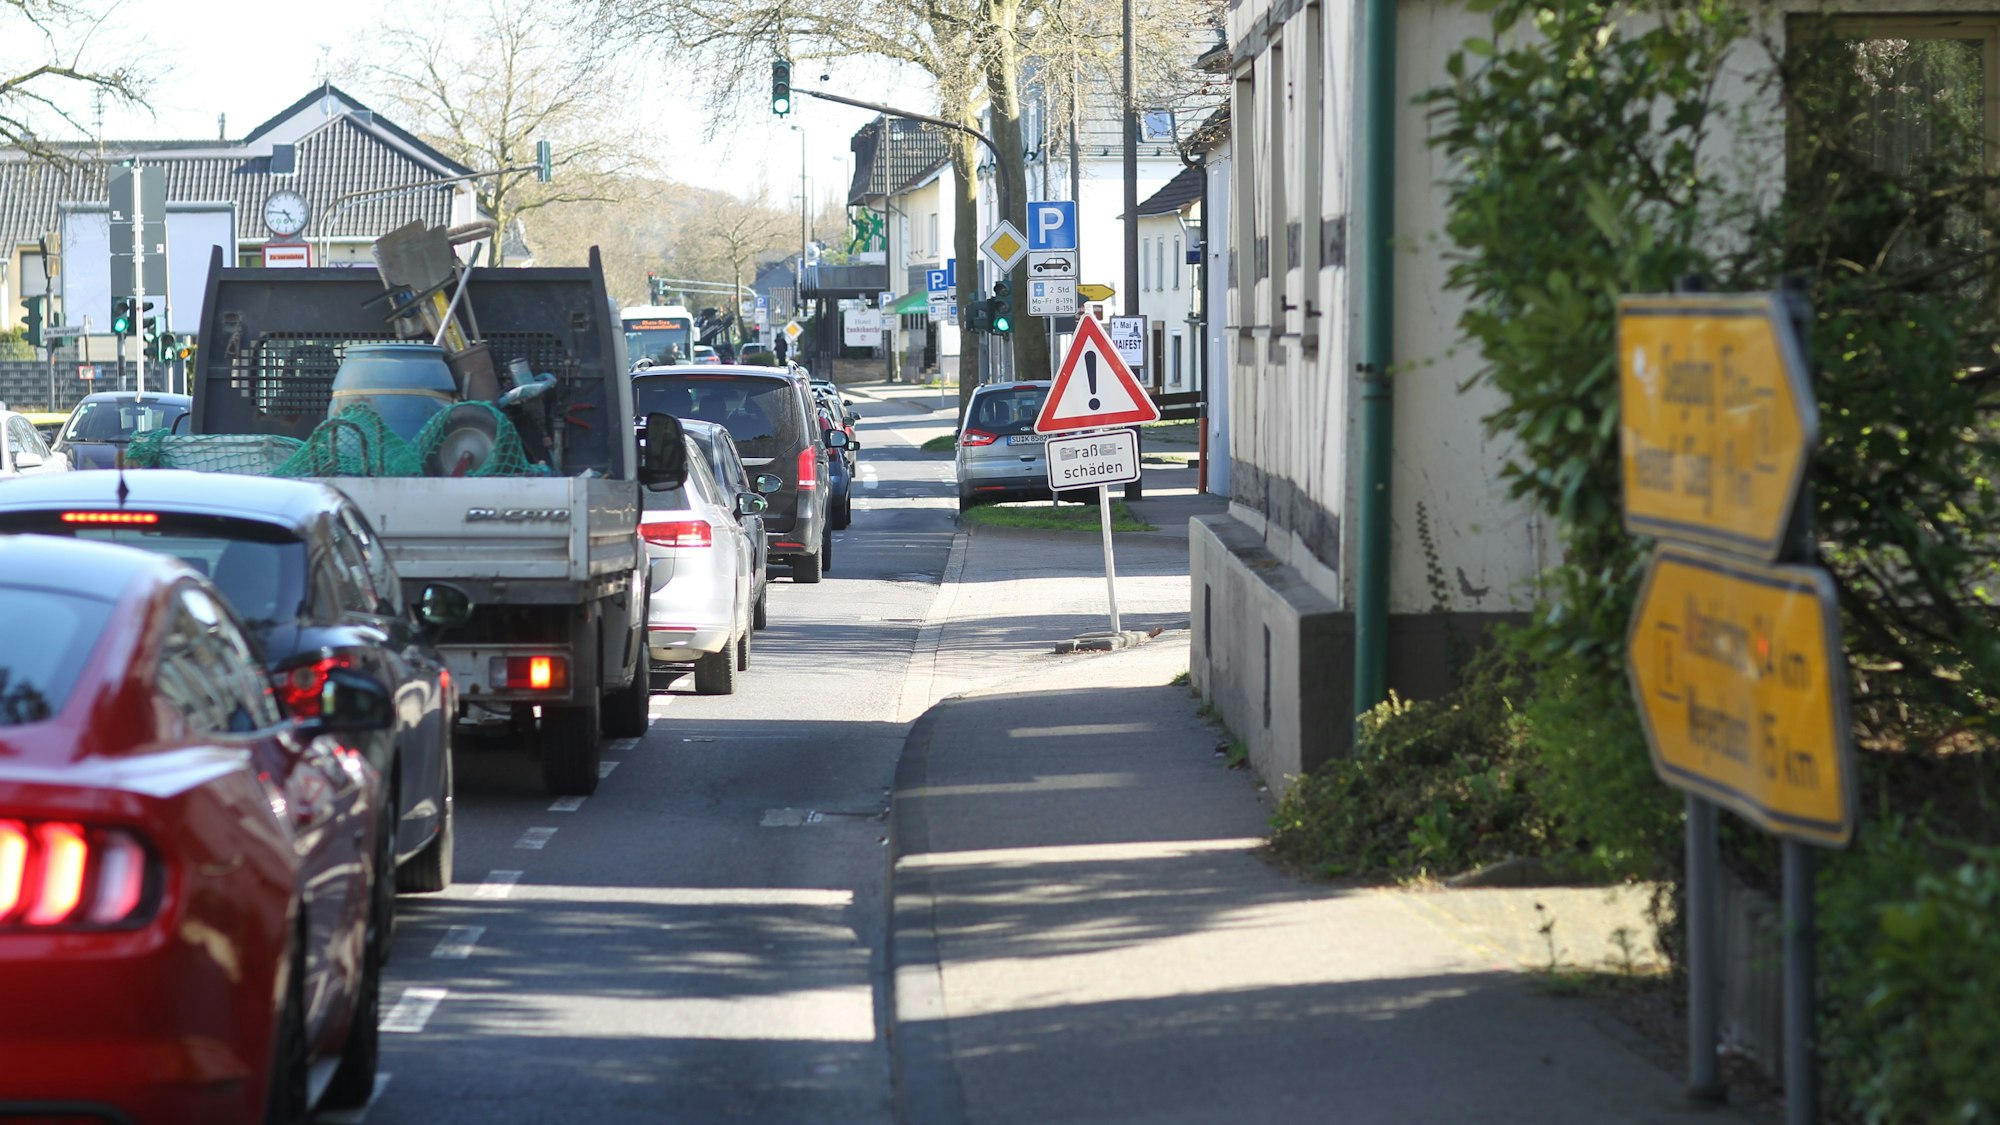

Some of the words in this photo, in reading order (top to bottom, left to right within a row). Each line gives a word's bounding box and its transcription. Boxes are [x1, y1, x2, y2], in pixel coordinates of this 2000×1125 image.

[1039, 208, 1064, 244] P
[932, 272, 944, 290] P
[1049, 286, 1055, 294] 2
[1113, 321, 1119, 329] 1.
[1120, 321, 1132, 329] Mai
[1011, 435, 1021, 443] SU
[1064, 462, 1123, 479] schäden
